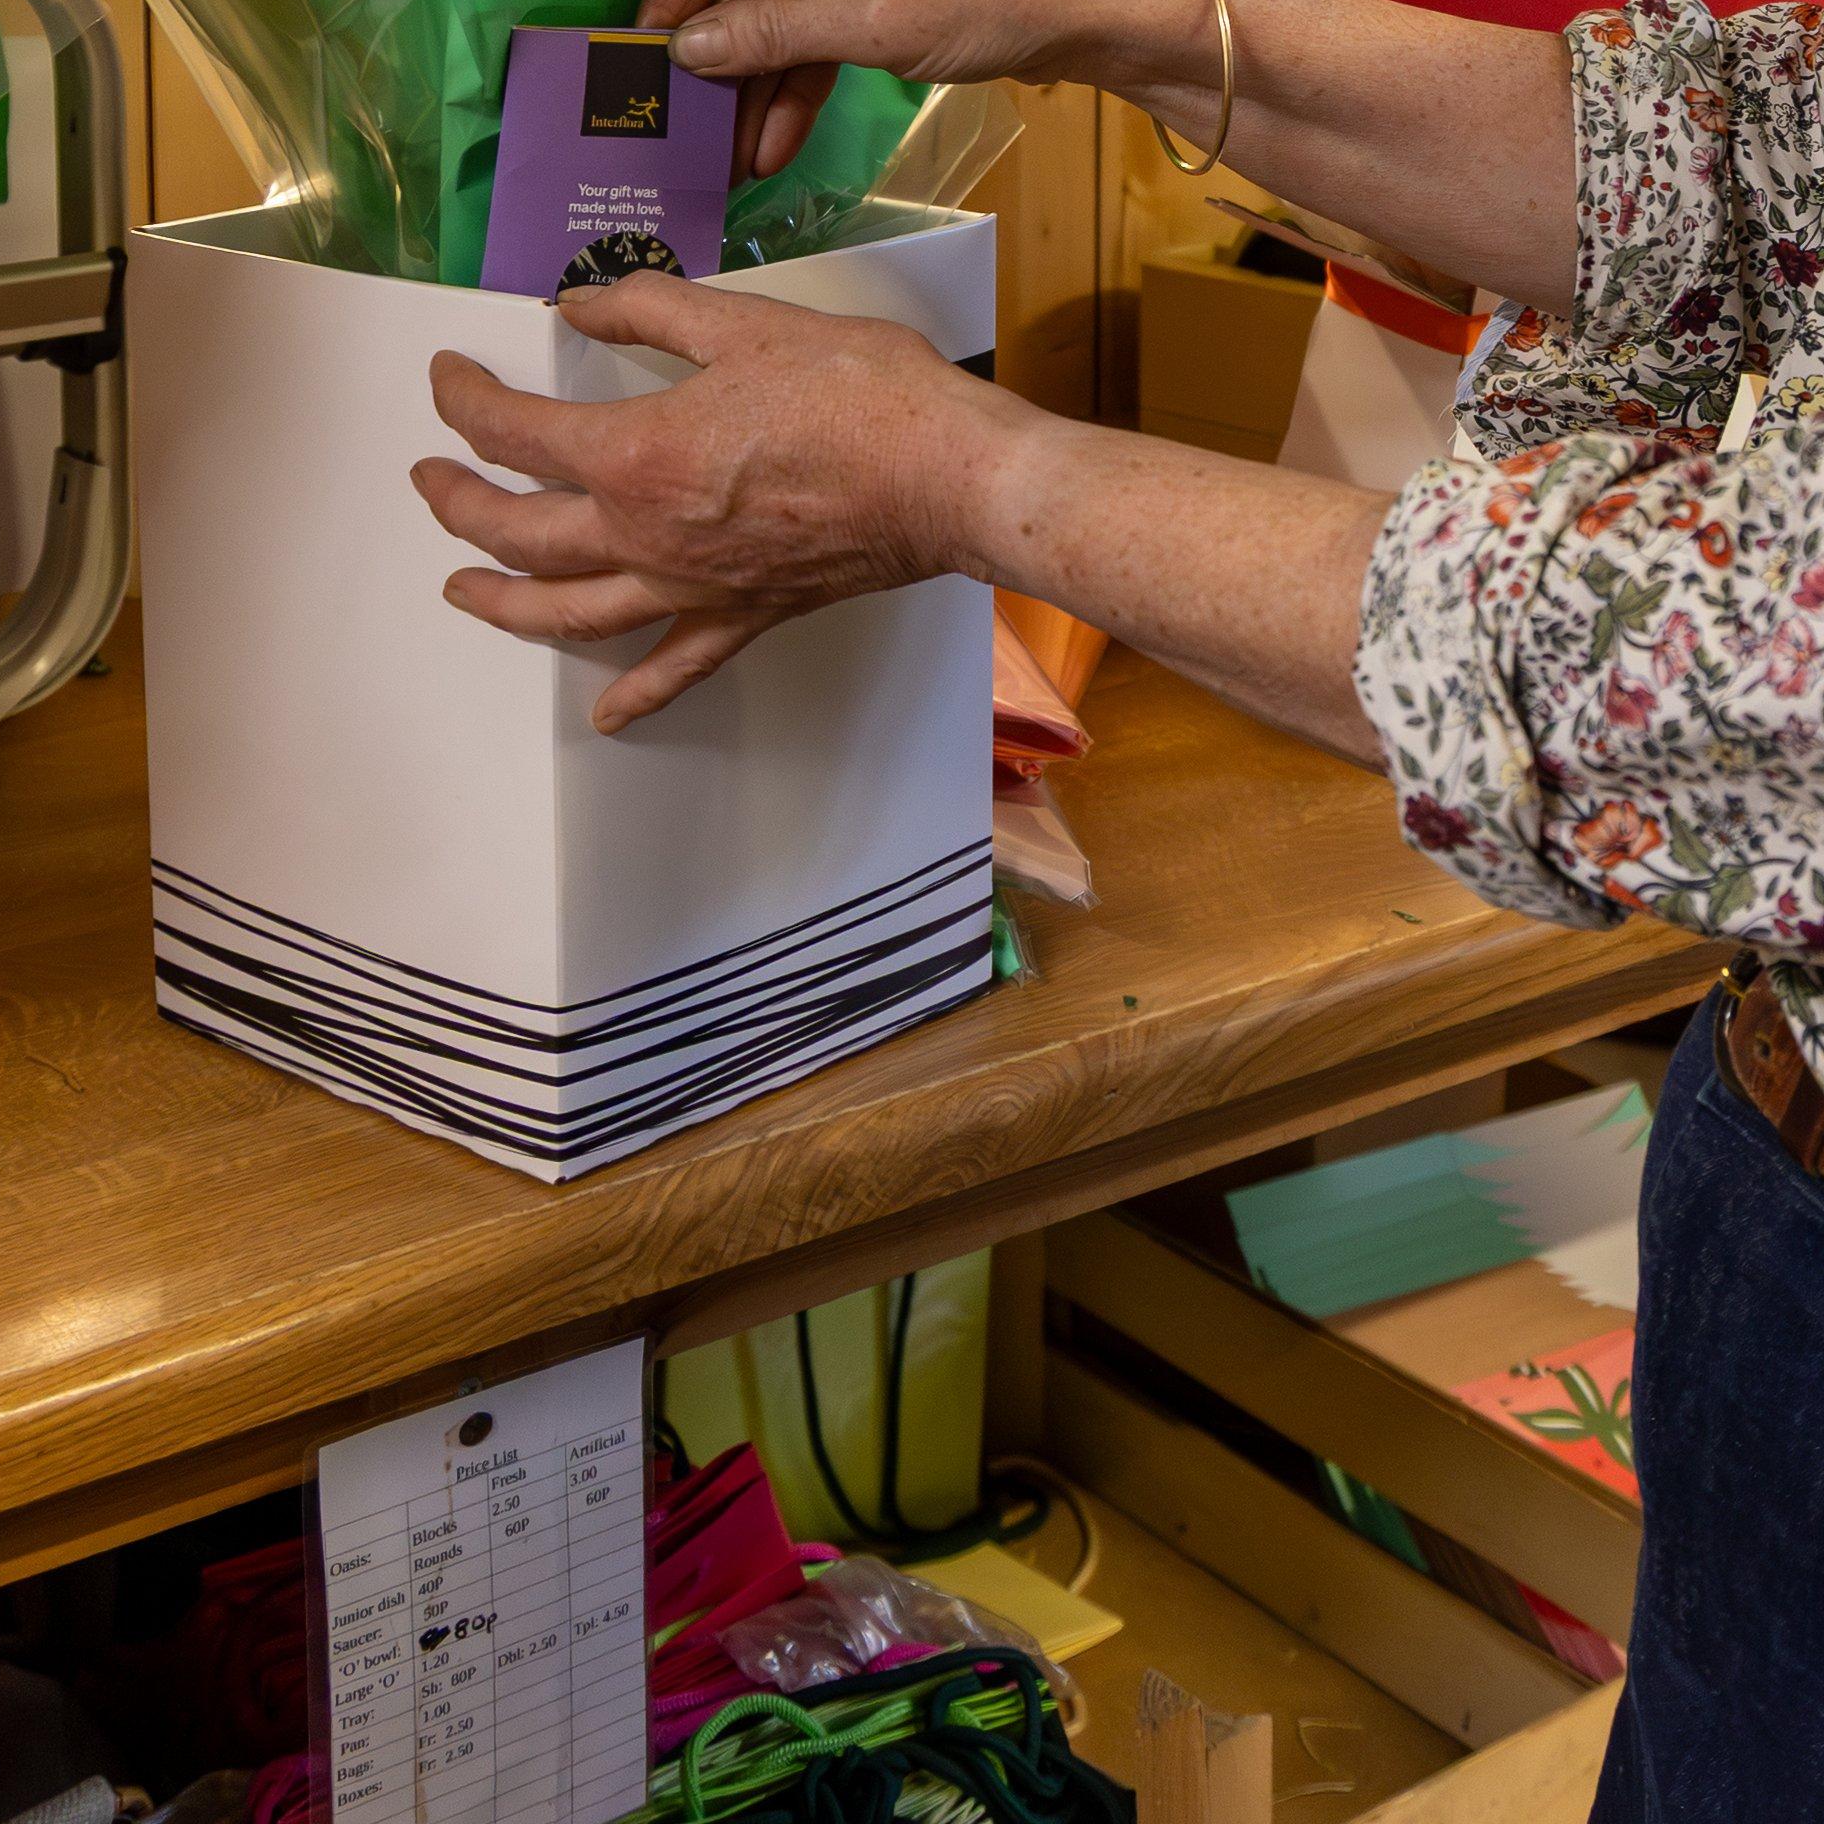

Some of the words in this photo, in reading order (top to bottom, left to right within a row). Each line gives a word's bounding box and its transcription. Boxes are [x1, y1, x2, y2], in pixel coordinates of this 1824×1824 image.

[591, 115, 643, 128] Interflora
[568, 203, 605, 214] made
[608, 203, 634, 214] with
[637, 204, 664, 217] love,
[578, 184, 608, 197] Your
[610, 185, 631, 199] gift
[634, 188, 658, 198] was
[567, 217, 592, 232] just
[595, 218, 612, 230] for
[615, 223, 641, 233] you,
[644, 221, 659, 235] by
[456, 1461, 489, 1481] Price
[494, 1449, 518, 1466] List
[491, 1468, 526, 1490] Fresh
[569, 1430, 625, 1461] Artificial
[330, 1553, 372, 1576] Oasis:
[412, 1520, 458, 1547] Blocks
[492, 1495, 520, 1516] 2.50
[570, 1466, 597, 1487] 3.00
[414, 1544, 463, 1572] Rounds
[505, 1517, 530, 1537] 60P
[586, 1487, 610, 1506] 60P
[332, 1605, 374, 1630] Junior
[378, 1592, 405, 1612] dish
[418, 1577, 443, 1595] 40P
[333, 1629, 383, 1655] Saucer:
[423, 1601, 448, 1621] 50P
[335, 1685, 374, 1707] Large
[422, 1652, 449, 1673] 1.20
[339, 1709, 375, 1730] Tray:
[497, 1645, 525, 1669] Dbl:
[528, 1635, 558, 1656] 2.50
[573, 1616, 599, 1639] Tpl:
[602, 1603, 629, 1625] 4.50
[364, 1645, 401, 1670] bowl:
[424, 1702, 450, 1723] 1.00
[337, 1760, 374, 1782] Bags:
[445, 1717, 474, 1739] 2.50
[338, 1781, 382, 1808] Boxes:
[445, 1742, 474, 1763] 2.50
